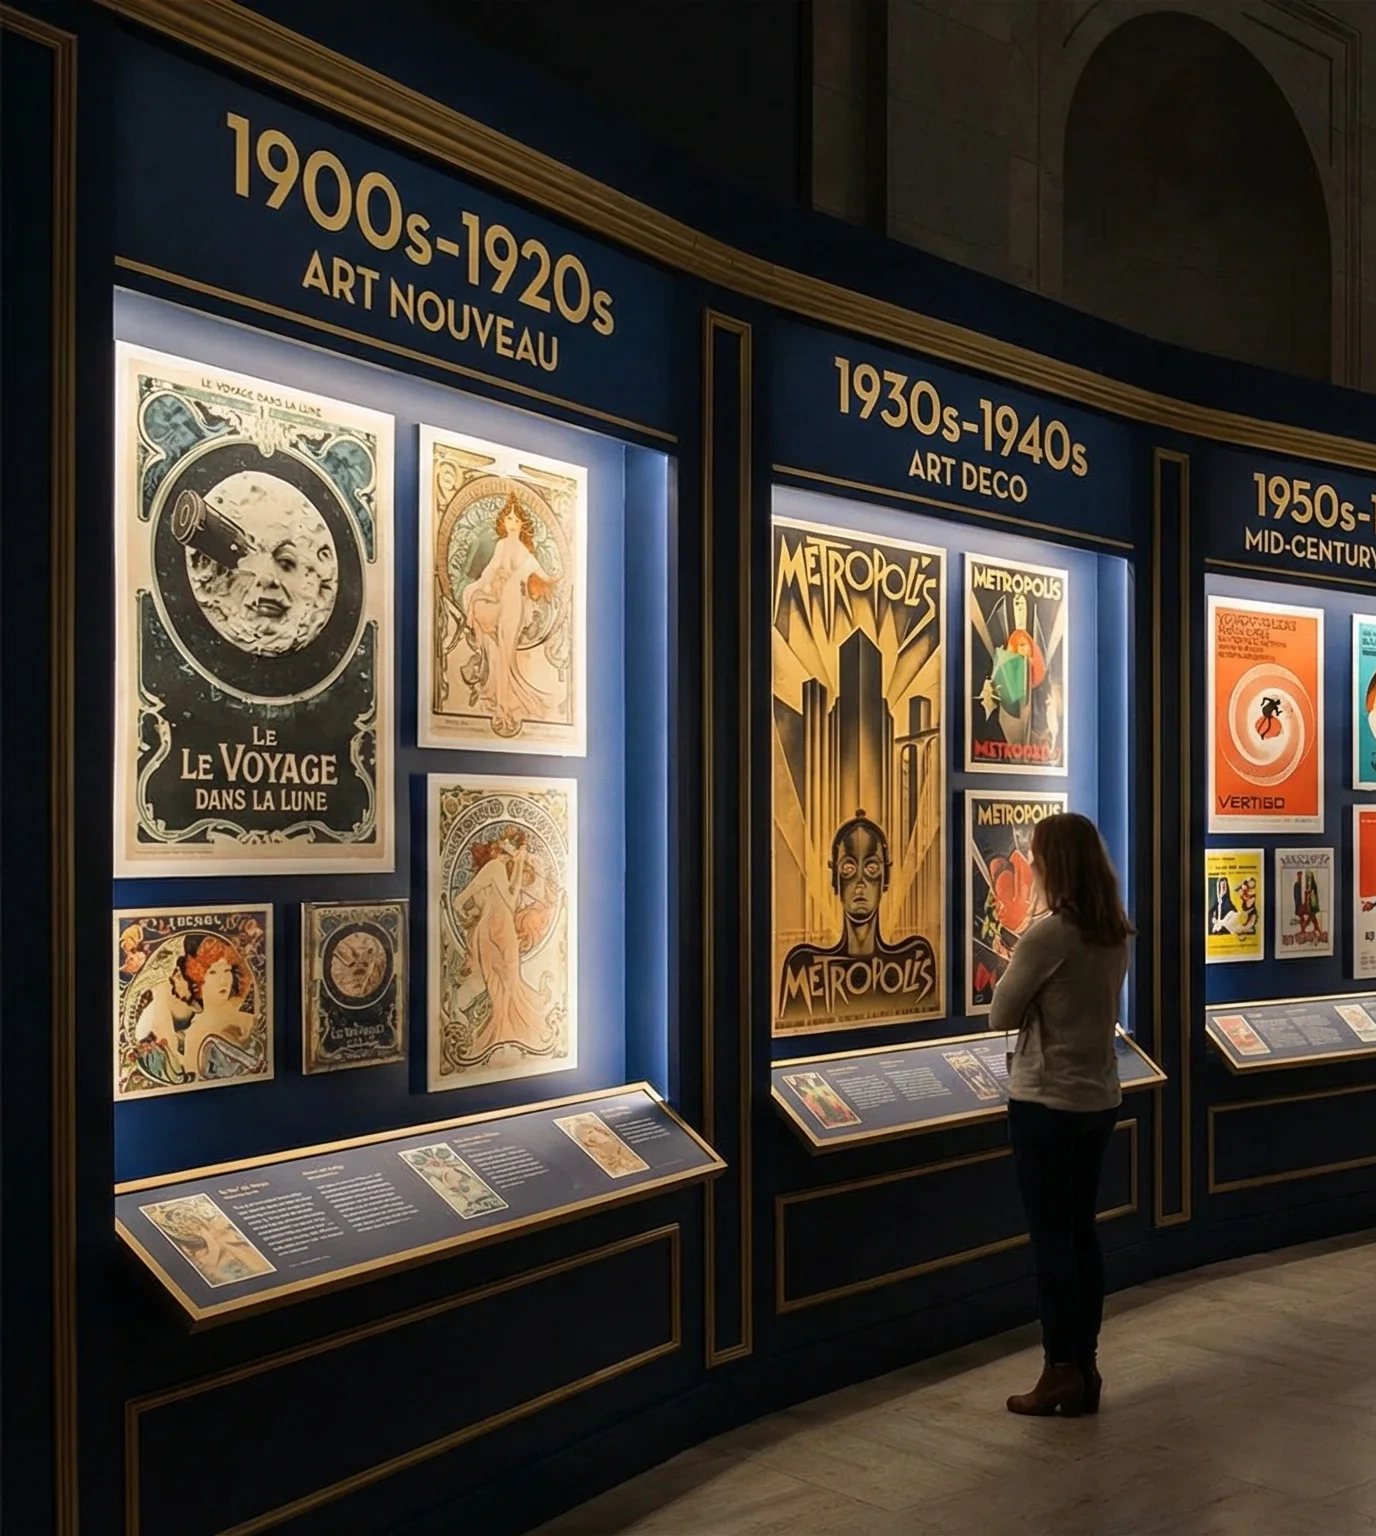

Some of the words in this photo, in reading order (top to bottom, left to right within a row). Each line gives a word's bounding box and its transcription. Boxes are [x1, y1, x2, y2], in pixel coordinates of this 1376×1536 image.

[227, 111, 615, 337] 1900s-1920s
[302, 249, 380, 311] ART
[390, 283, 559, 372] NOUVEAU
[834, 355, 1089, 477] 1930s-1940s
[908, 449, 957, 486] ART
[962, 461, 1029, 503] DECO
[974, 565, 1061, 601] METROPOLIS
[252, 725, 278, 746] LE
[180, 747, 214, 781] LE
[218, 742, 338, 785] VOYAGE
[195, 788, 247, 811] DANS
[252, 789, 276, 811] LA
[280, 788, 328, 812] LUNE
[1218, 794, 1286, 810] VERTIGO
